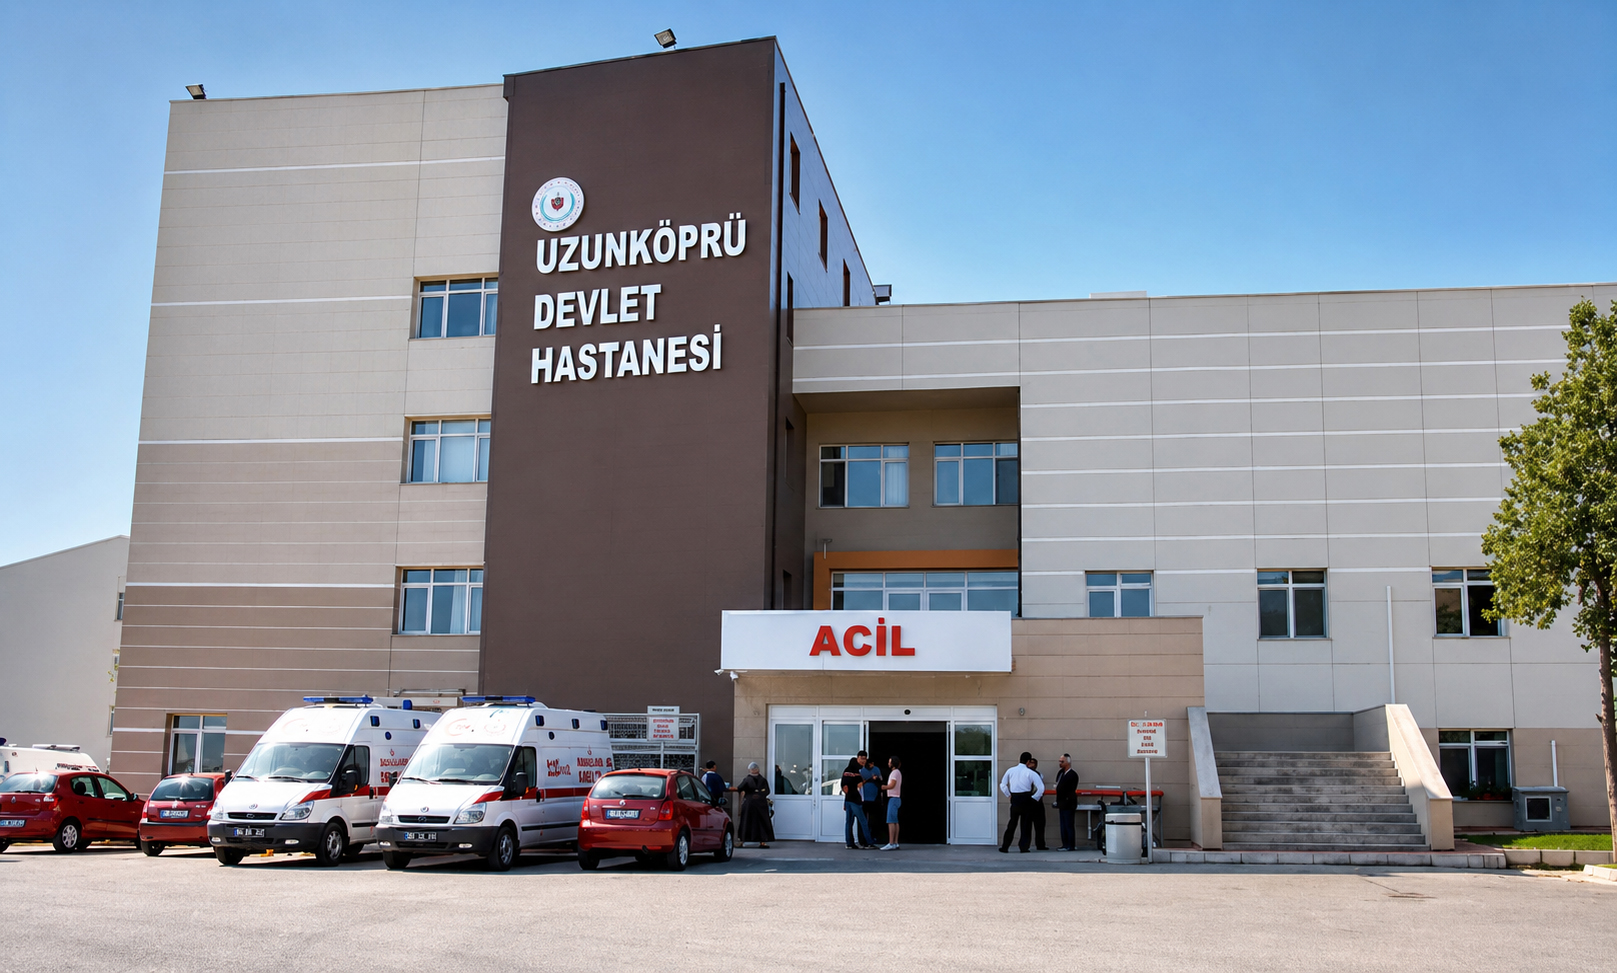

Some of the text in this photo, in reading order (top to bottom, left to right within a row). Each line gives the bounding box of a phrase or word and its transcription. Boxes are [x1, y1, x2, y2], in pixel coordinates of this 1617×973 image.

[536, 212, 746, 274] UZUNKÖPRÜ
[533, 283, 662, 330] DEVLET
[530, 323, 722, 384] HASTANESİ
[809, 617, 915, 656] ACİL
